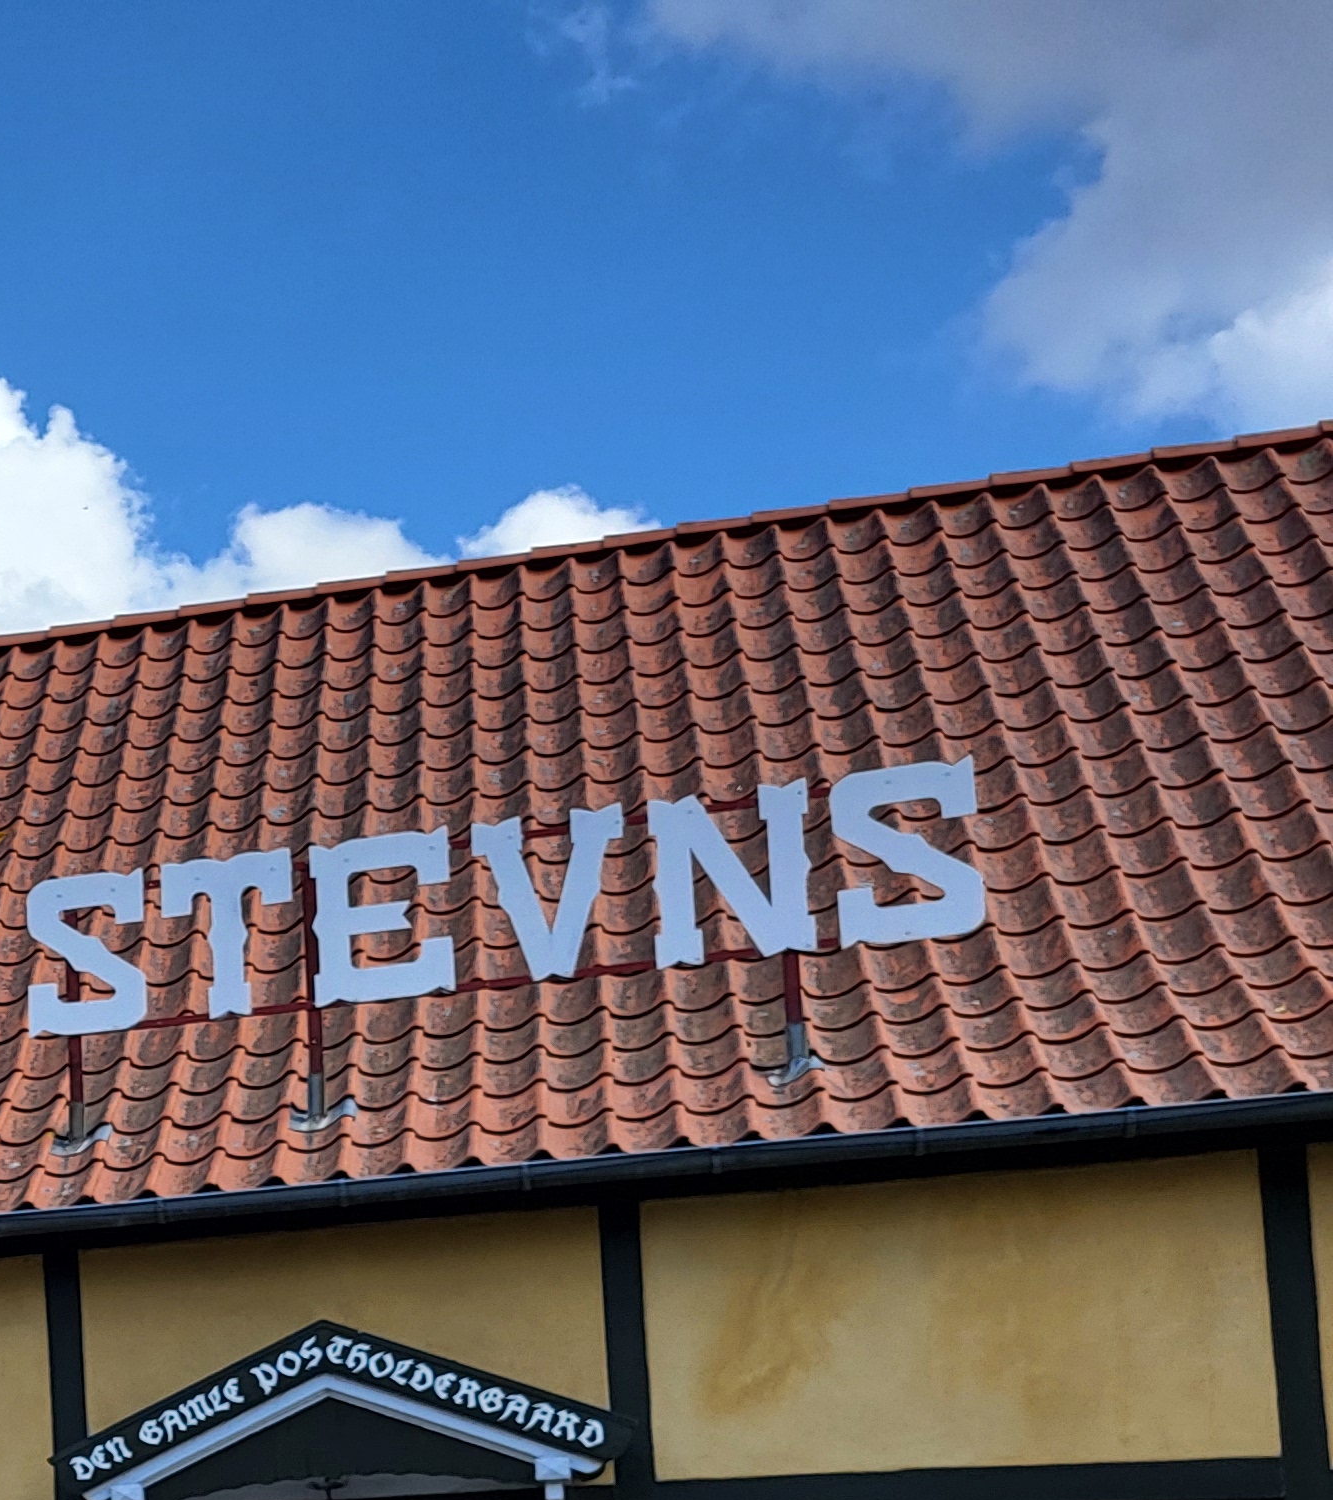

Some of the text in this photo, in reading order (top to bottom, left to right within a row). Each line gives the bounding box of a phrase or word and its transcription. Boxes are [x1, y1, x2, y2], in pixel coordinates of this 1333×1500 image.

[26, 754, 984, 1037] STEVNS
[69, 1435, 132, 1481] DEN
[138, 1377, 245, 1447] GAMLE
